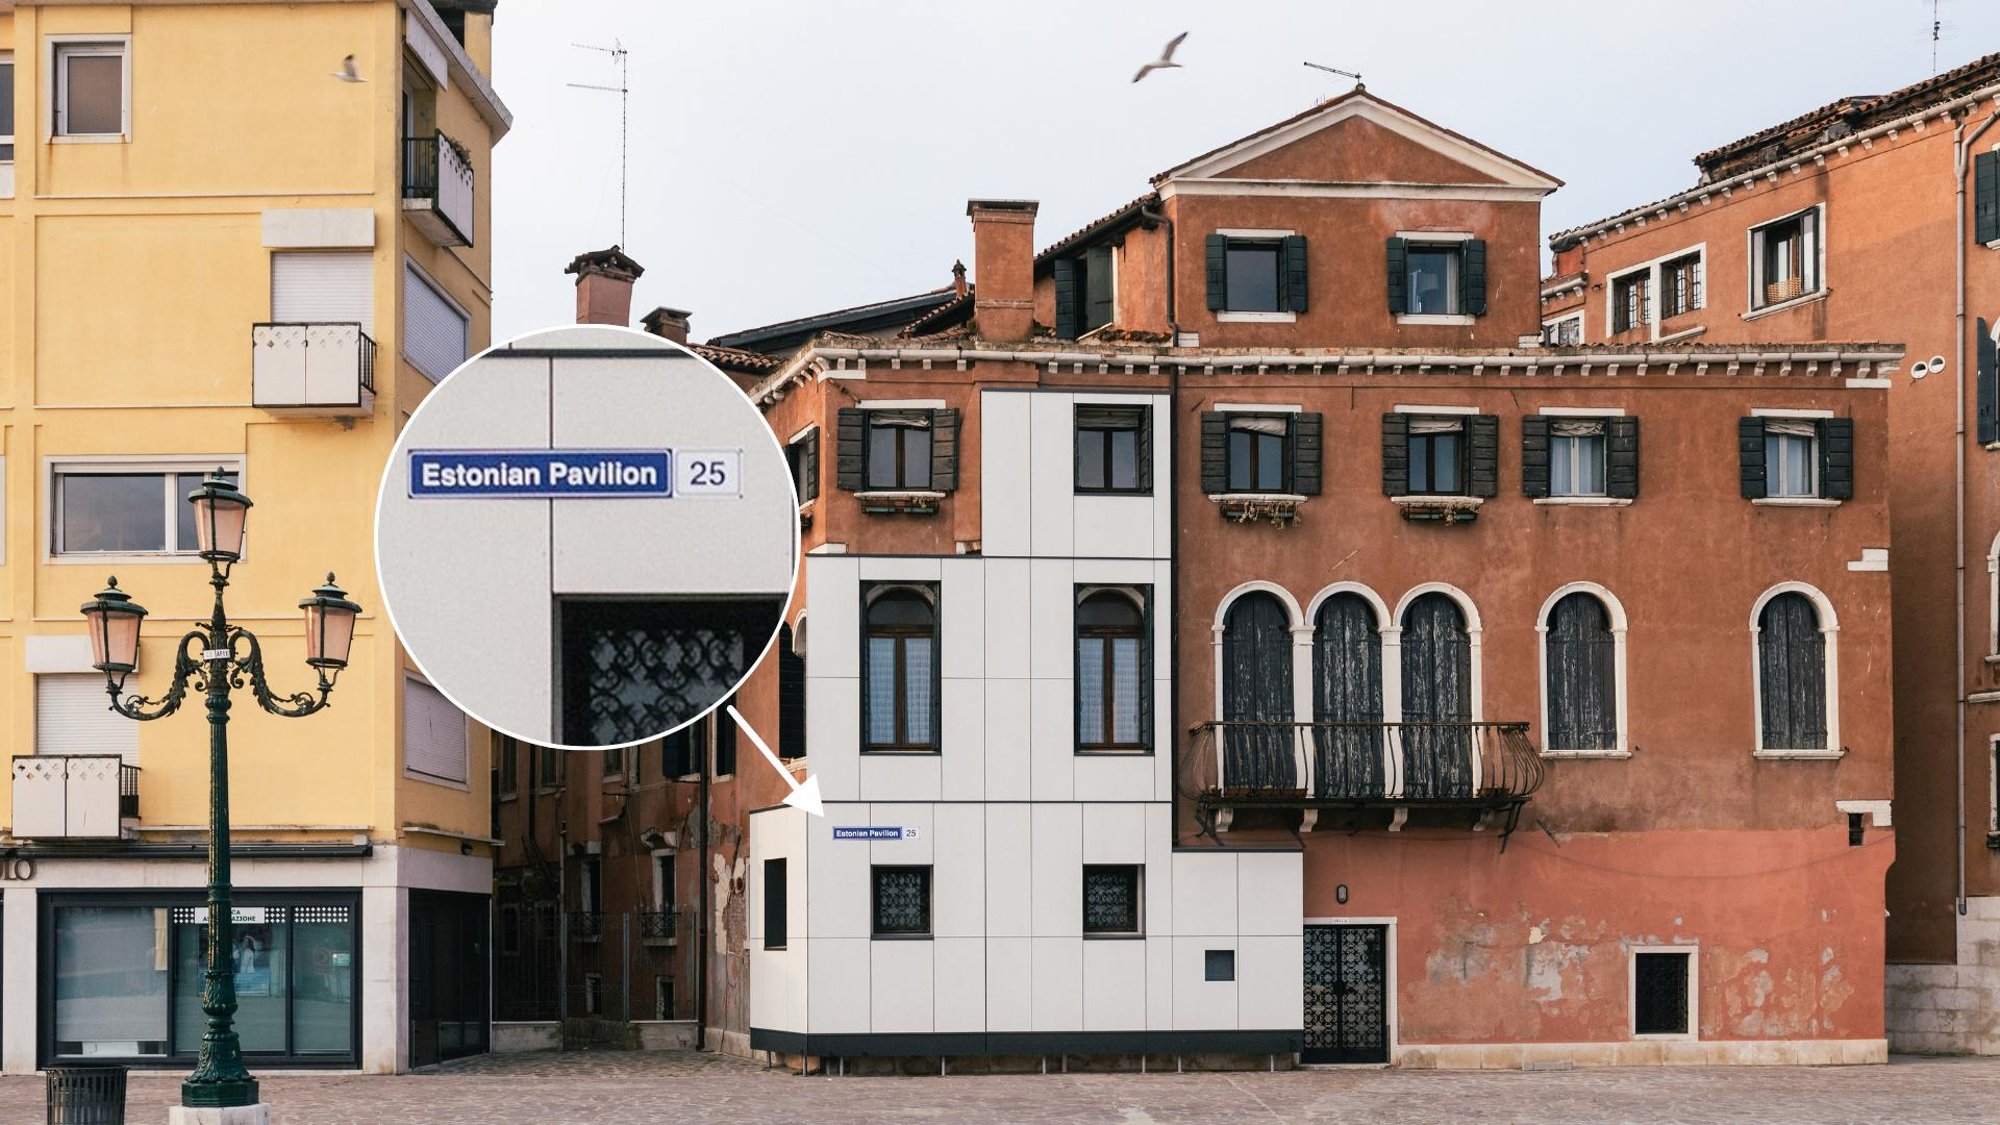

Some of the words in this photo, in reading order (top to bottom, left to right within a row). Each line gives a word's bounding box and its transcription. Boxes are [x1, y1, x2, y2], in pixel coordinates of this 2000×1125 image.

[422, 463, 541, 487] Estonian
[549, 462, 657, 486] Pavilion
[689, 461, 726, 485] 25
[836, 829, 868, 837] Estonian
[869, 829, 899, 837] Pavilion
[906, 829, 917, 837] 25
[0, 858, 35, 881] LO
